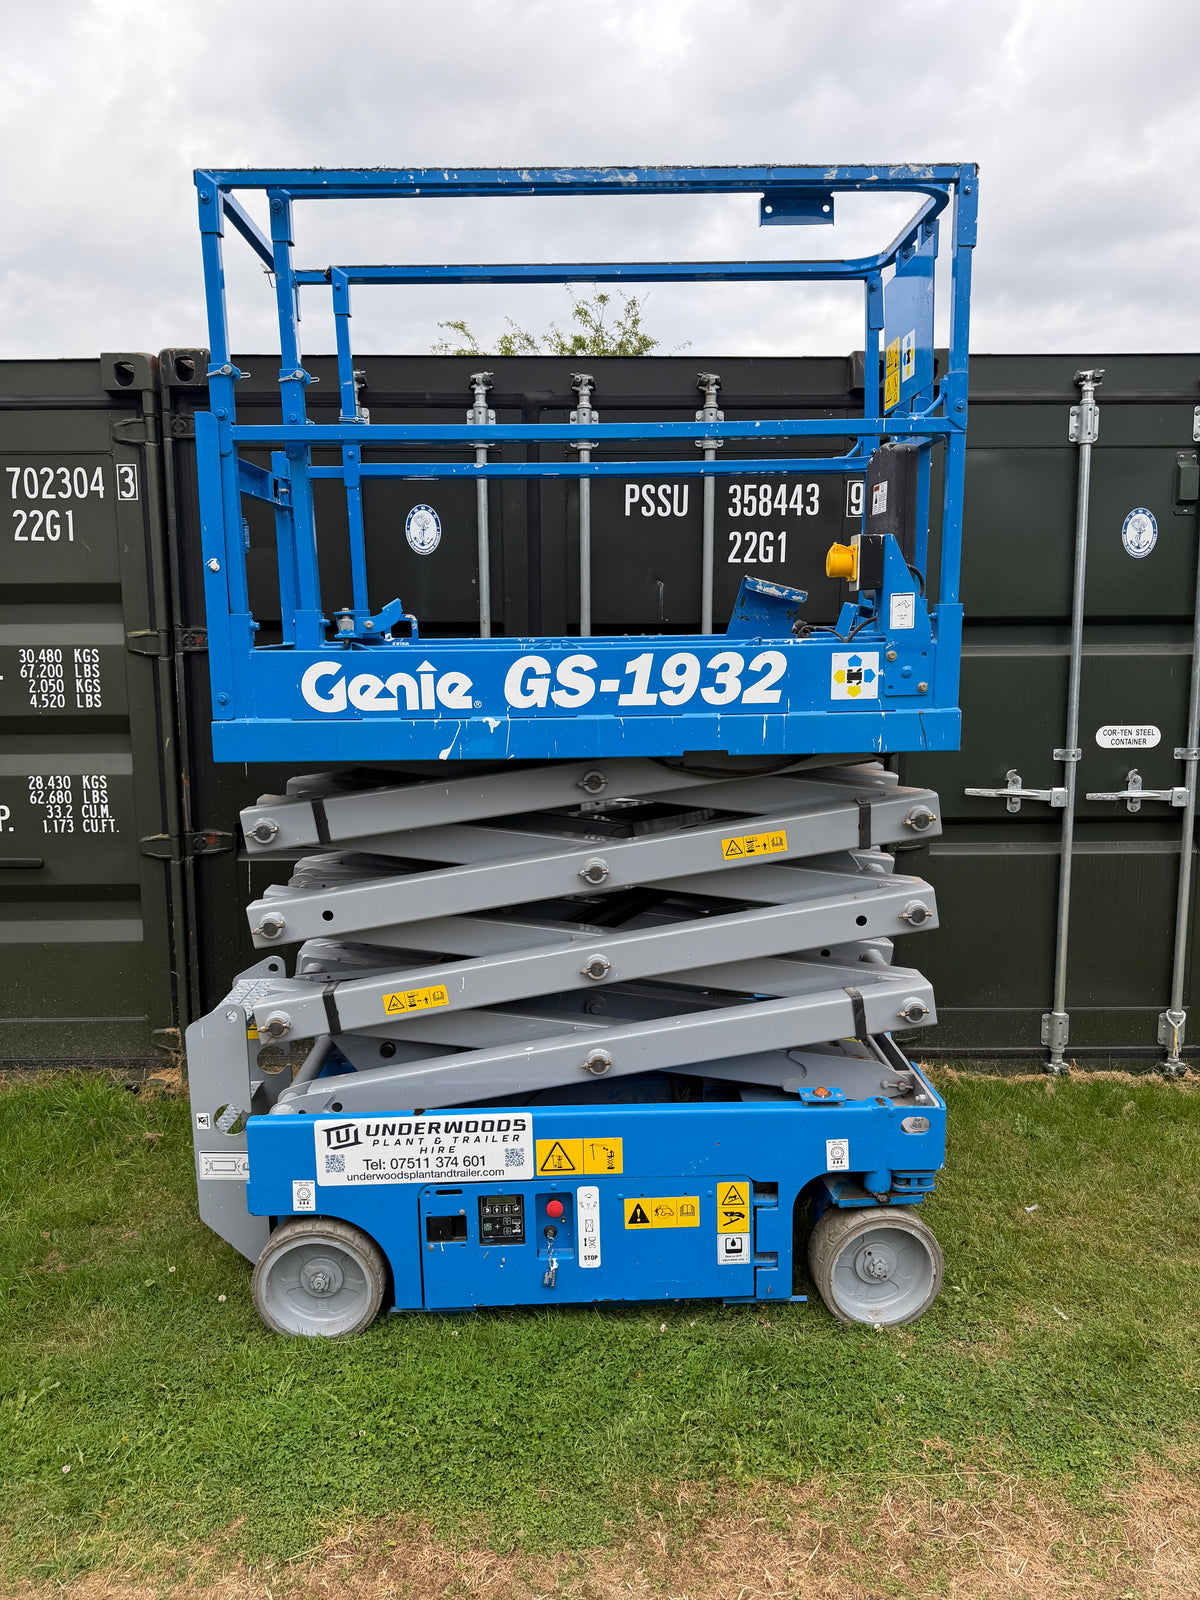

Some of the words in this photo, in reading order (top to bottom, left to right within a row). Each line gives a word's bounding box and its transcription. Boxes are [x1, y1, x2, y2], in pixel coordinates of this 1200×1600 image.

[5, 466, 105, 499] 702304
[119, 466, 136, 498] 3
[624, 483, 689, 517] PSSU
[727, 483, 821, 517] 358443
[850, 482, 864, 515] 9
[12, 509, 75, 542] 22G1
[727, 530, 787, 564] 22G1
[73, 648, 100, 663] KGS
[75, 663, 100, 678] LBS
[76, 679, 101, 693] KGS
[503, 650, 788, 709] GS-1932
[76, 694, 102, 708] LBS
[1102, 728, 1133, 737] COR-TEN
[1135, 728, 1156, 736] STEEL
[1110, 737, 1147, 746] CONTAINER
[82, 775, 108, 789] KGS
[83, 790, 109, 804] LBS
[46, 804, 73, 819] 33.2
[365, 1119, 527, 1137] UNDERWOODS
[372, 1137, 426, 1147] PLANT
[434, 1136, 442, 1145] &
[452, 1134, 521, 1144] TRAILER
[419, 1146, 456, 1155] HIRE
[362, 1158, 386, 1171] Tel:
[390, 1157, 430, 1170] 07511
[435, 1156, 459, 1168] 374
[462, 1155, 486, 1168] 601
[346, 1168, 505, 1182] underwoodsplantandtrailer.com
